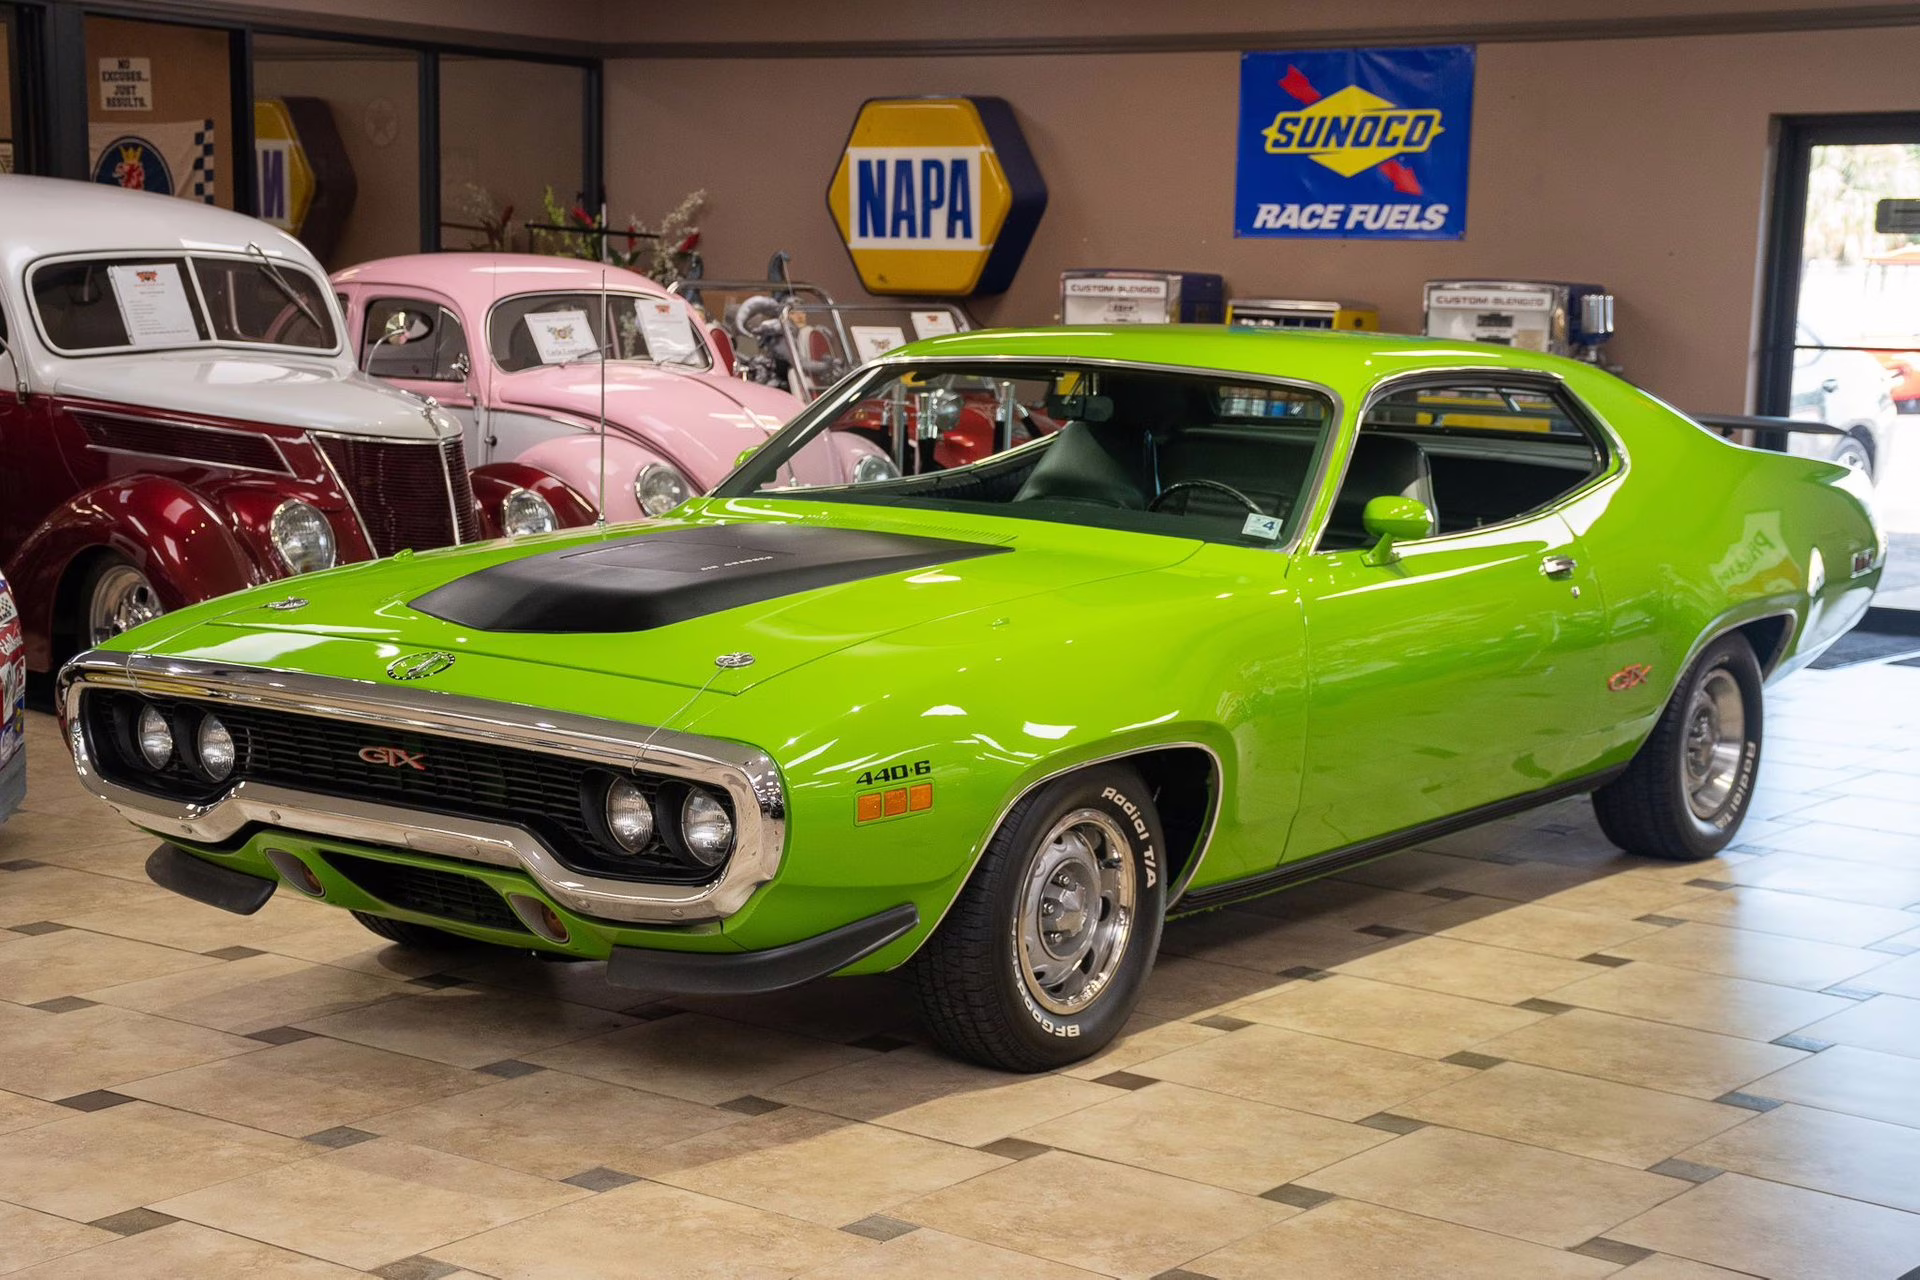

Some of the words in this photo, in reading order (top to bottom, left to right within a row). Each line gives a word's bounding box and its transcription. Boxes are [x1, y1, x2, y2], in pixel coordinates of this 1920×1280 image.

[1271, 115, 1435, 149] SUNOCO
[858, 159, 972, 239] NAPA
[1253, 204, 1344, 229] RACE
[1345, 203, 1449, 231] FUELS
[1070, 283, 1115, 293] CUSTOM
[1435, 295, 1487, 304] CUSTOM
[1607, 662, 1652, 692] GTX
[358, 746, 426, 770] GTX
[1101, 786, 1151, 840] Radial
[1143, 844, 1157, 889] T/A
